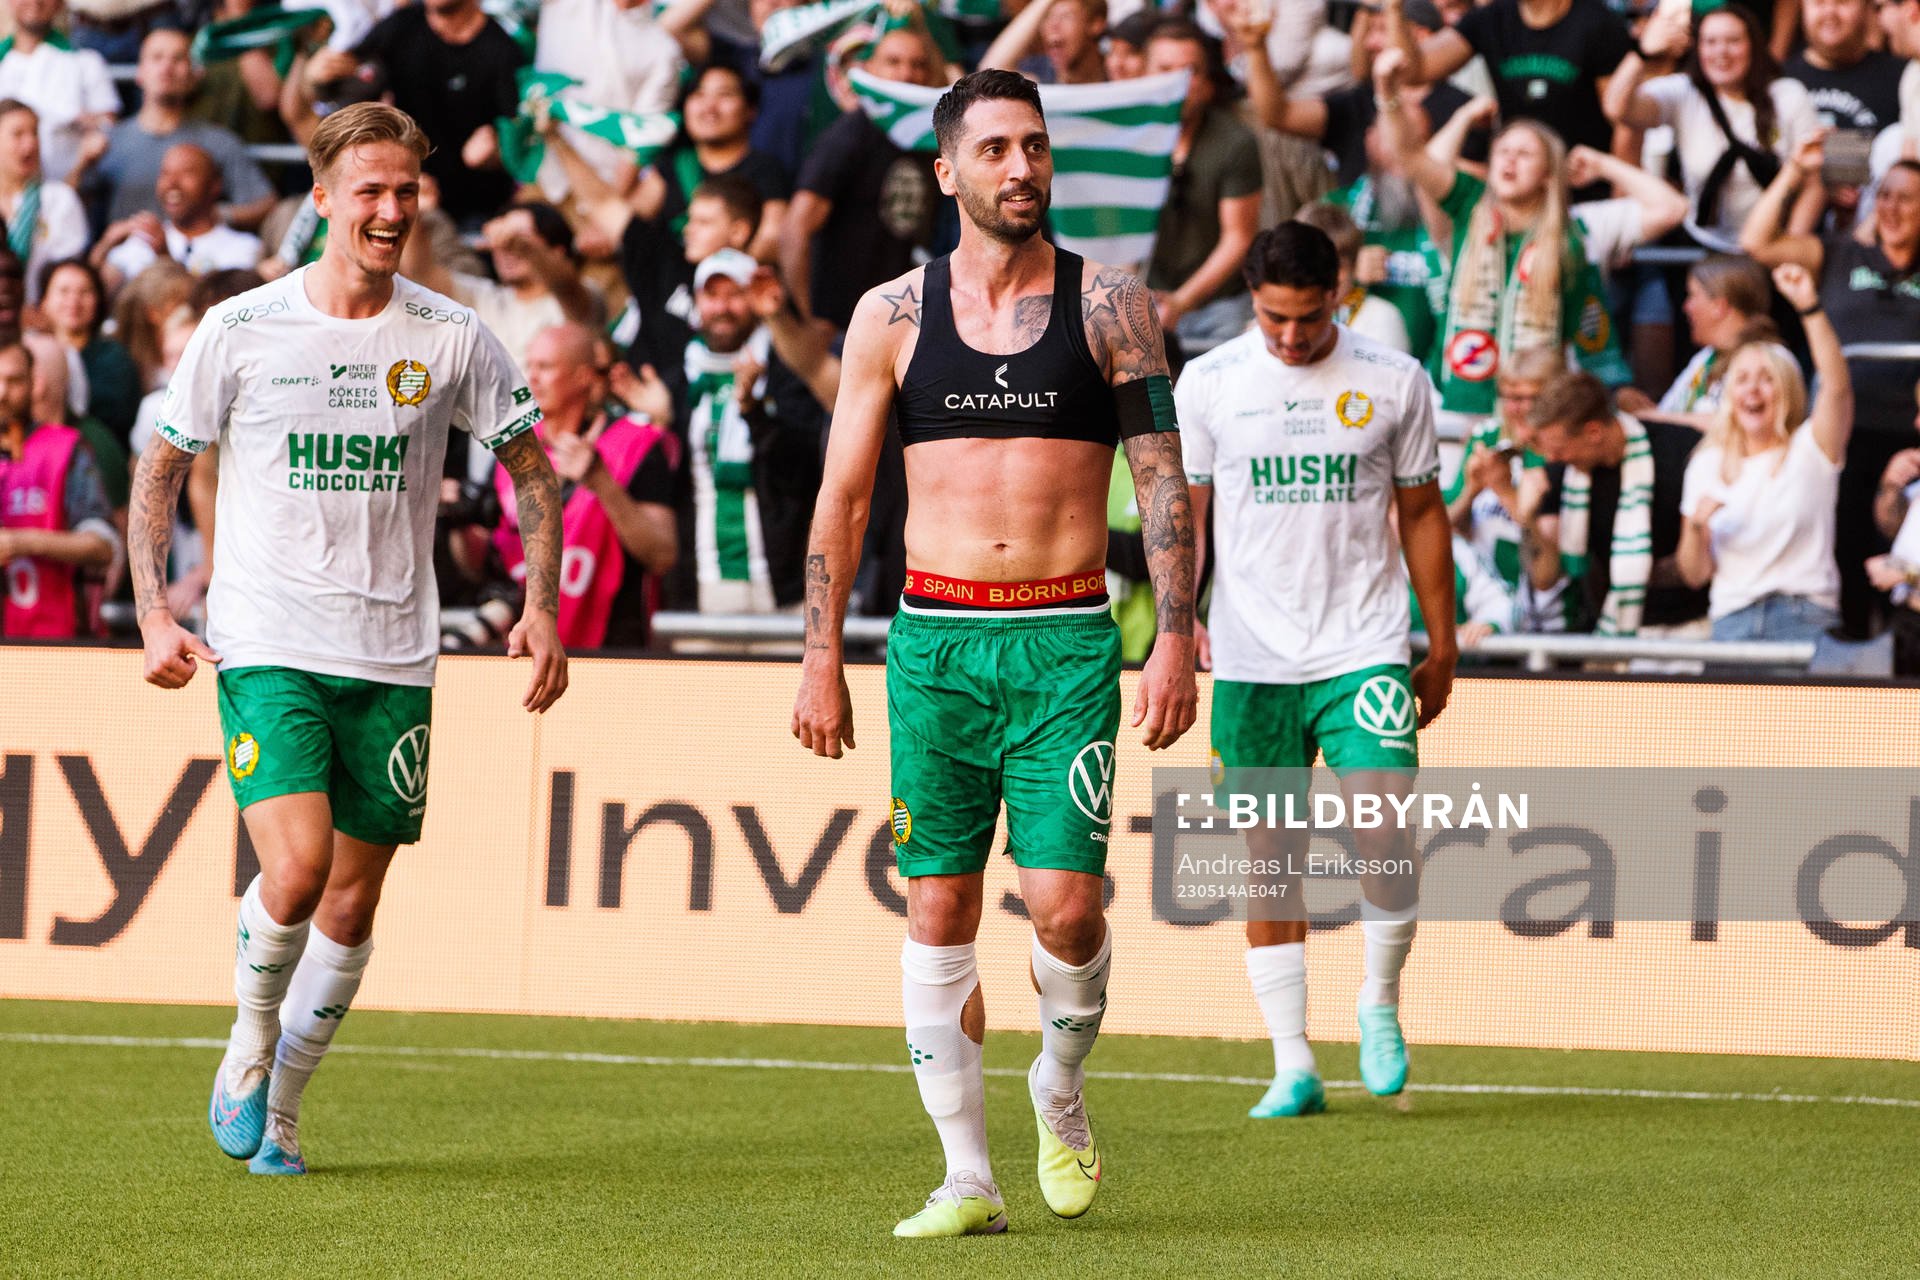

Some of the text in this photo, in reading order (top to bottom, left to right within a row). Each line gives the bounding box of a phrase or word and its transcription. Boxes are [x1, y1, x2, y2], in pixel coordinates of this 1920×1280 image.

[222, 296, 290, 330] sesol
[405, 302, 470, 327] sesol
[348, 364, 377, 372] INTER
[348, 372, 376, 380] SPORT
[271, 377, 311, 386] CRAFT
[944, 391, 1058, 410] CATAPULT
[288, 433, 409, 472] HUSKI
[1251, 454, 1358, 486] HUSKI
[289, 472, 407, 493] CHOCOLATE
[1254, 486, 1357, 504] CHOCOLATE
[923, 577, 974, 600] SPAIN
[989, 581, 1067, 602] BJÖRN
